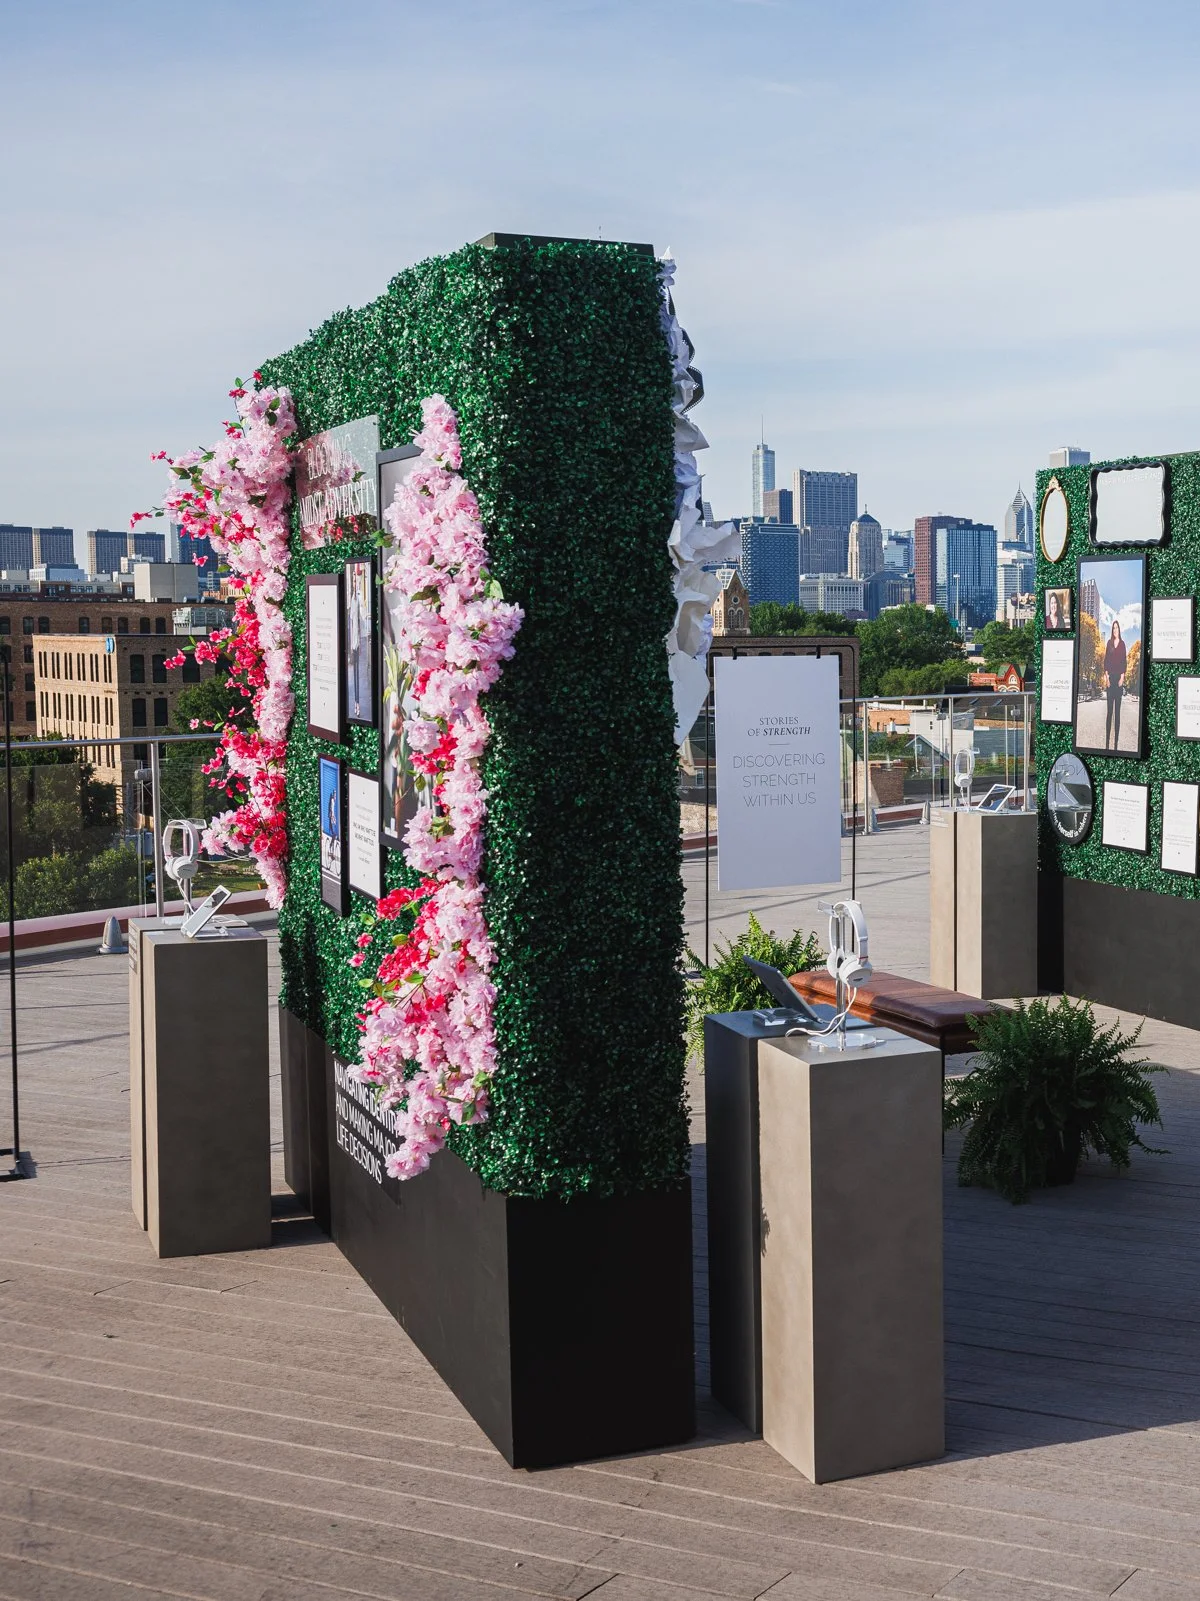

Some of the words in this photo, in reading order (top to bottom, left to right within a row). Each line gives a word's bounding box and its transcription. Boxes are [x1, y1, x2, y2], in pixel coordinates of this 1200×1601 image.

[760, 716, 799, 726] STORIES
[747, 727, 760, 737] OF
[763, 726, 811, 736] STRENGTH
[733, 753, 825, 769] DISCOVERING
[743, 772, 816, 788] STRENGTH
[744, 793, 793, 807] WITHIN
[798, 791, 817, 805] US
[336, 1092, 349, 1121] AND
[349, 1103, 373, 1146] MAKING
[336, 1120, 349, 1153] LIFE
[350, 1133, 383, 1185] DECISIONS
